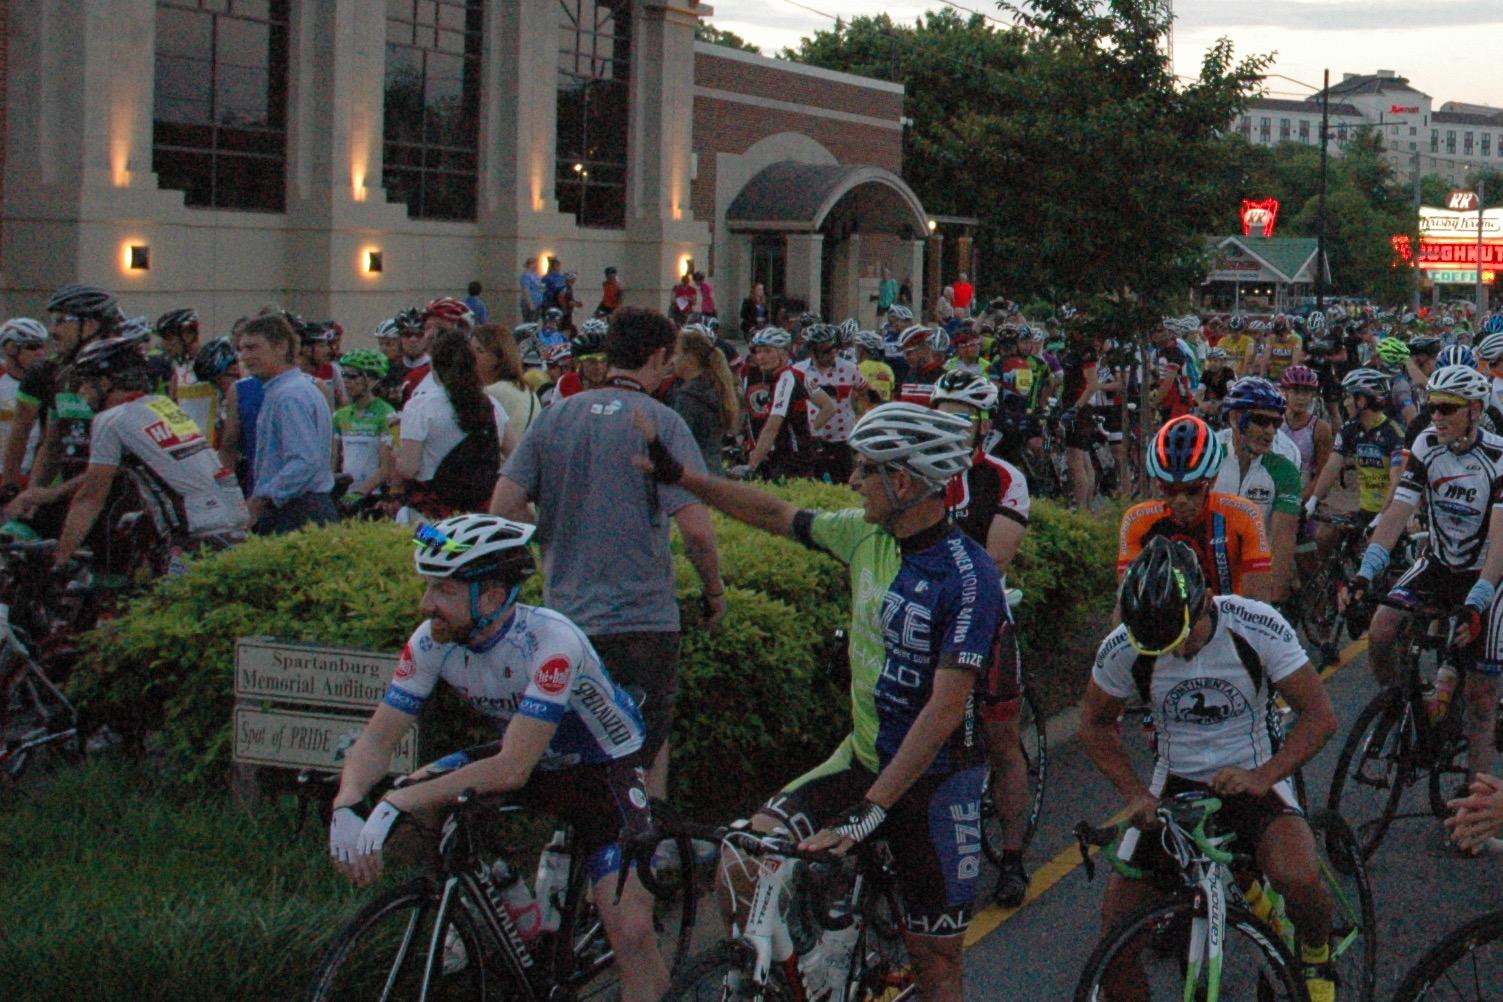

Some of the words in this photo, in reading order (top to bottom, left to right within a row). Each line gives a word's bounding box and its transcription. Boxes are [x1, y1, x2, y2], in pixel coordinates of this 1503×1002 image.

[1449, 192, 1472, 208] KK
[947, 538, 975, 573] POWER
[960, 573, 978, 606] YOUR
[953, 607, 978, 644] MIND
[1220, 600, 1285, 636] Continental
[272, 652, 380, 679] Spartanburg
[958, 651, 984, 668] RIZE
[1096, 631, 1129, 669] Contine
[243, 668, 315, 694] Memorial
[323, 676, 388, 701] Auditori
[1166, 679, 1240, 706] CONTINENTAL
[573, 681, 631, 746] SPECIALIZED
[241, 719, 266, 752] Spot
[271, 724, 287, 753] of
[291, 726, 333, 753] PRIDE
[394, 734, 410, 759] 04
[949, 800, 982, 880] RIZE
[907, 909, 970, 934] HAL
